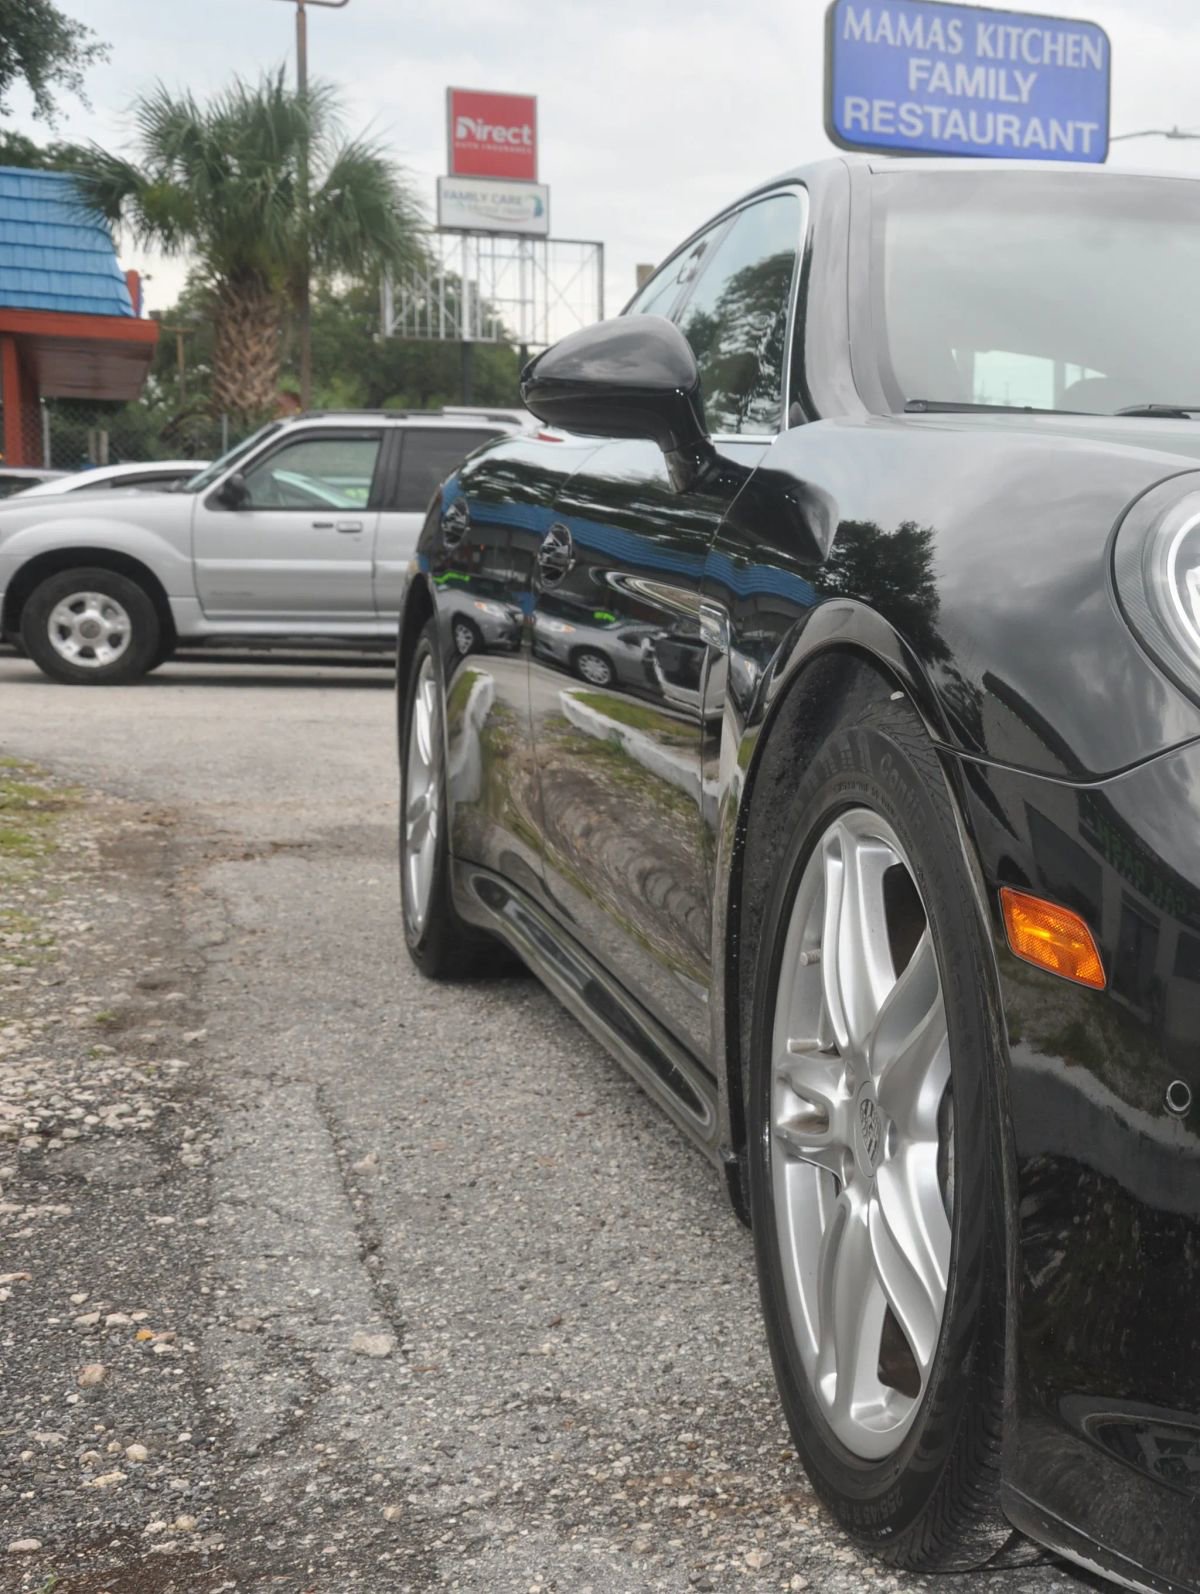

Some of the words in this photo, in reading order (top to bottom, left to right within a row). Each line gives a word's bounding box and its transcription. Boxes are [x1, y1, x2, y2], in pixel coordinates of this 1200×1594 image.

[843, 5, 963, 55] MAMAS
[975, 22, 1103, 71] KITCHEN
[908, 57, 1038, 104] FAMILY
[455, 115, 532, 146] Direct
[842, 95, 1099, 154] RESTAURANT
[442, 189, 489, 202] FAMILY
[491, 193, 523, 206] CARE
